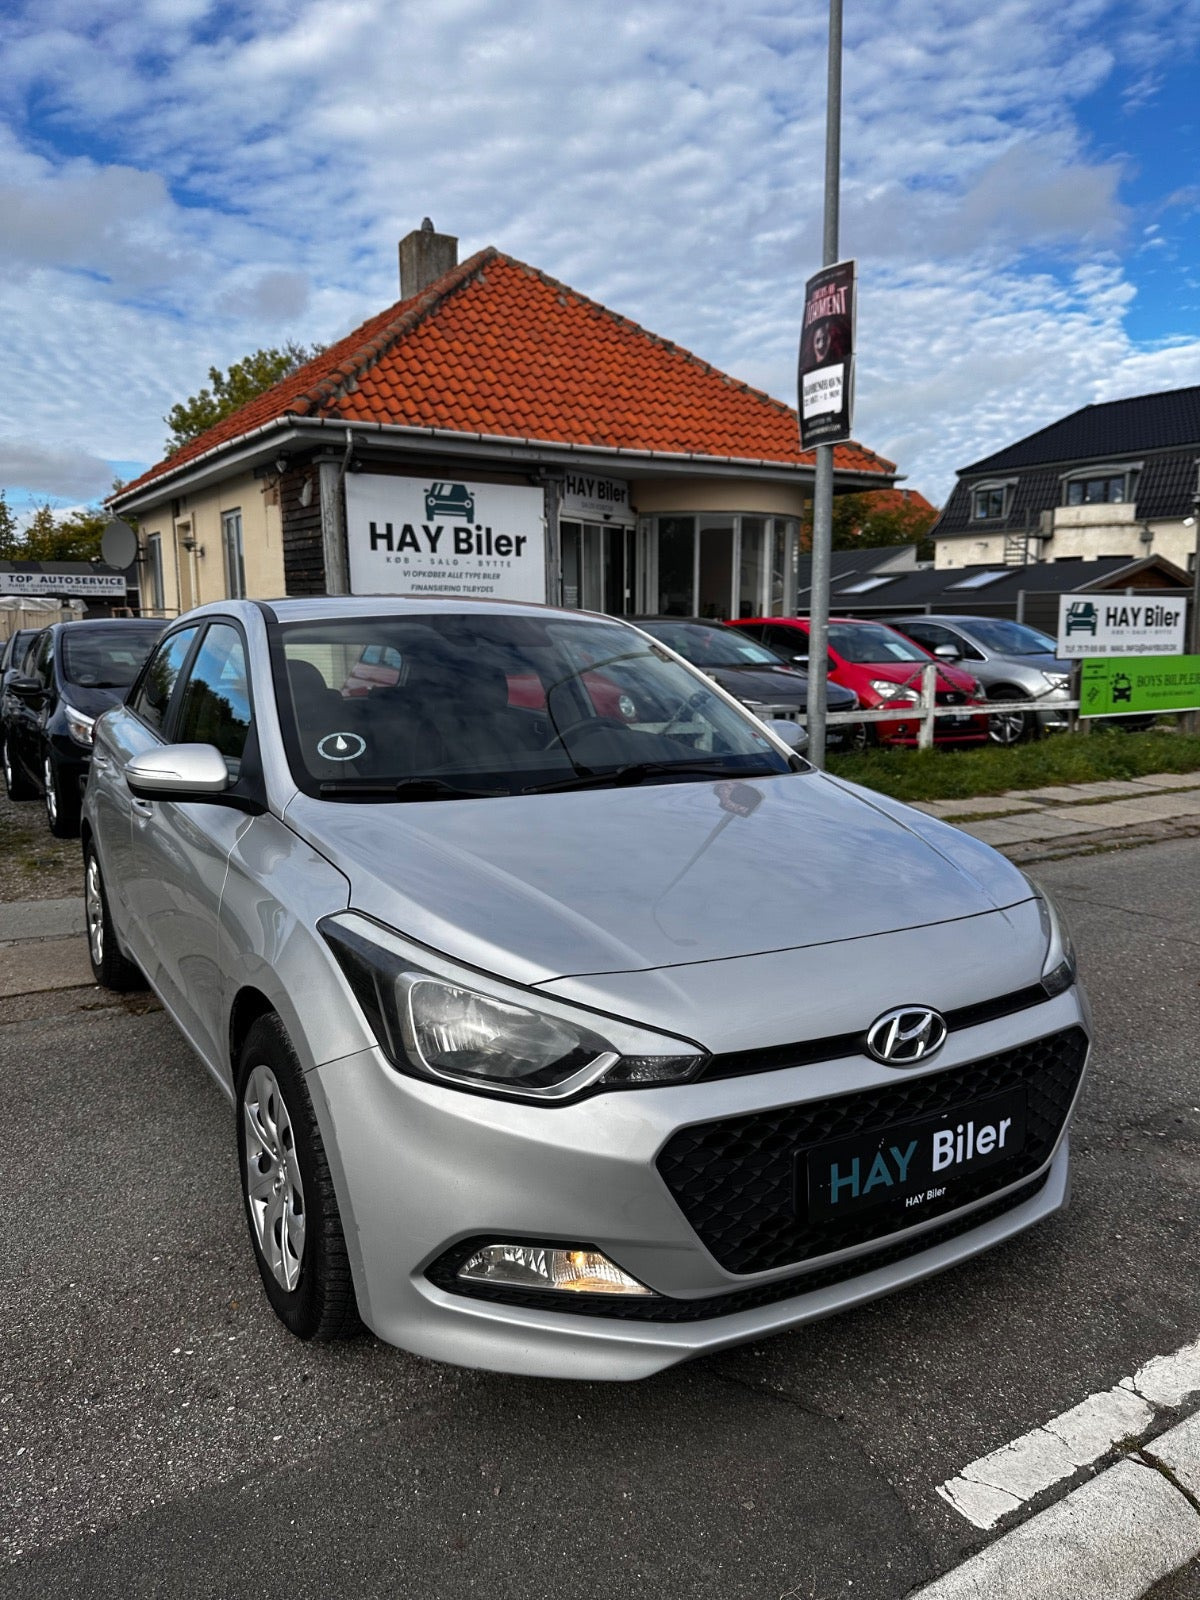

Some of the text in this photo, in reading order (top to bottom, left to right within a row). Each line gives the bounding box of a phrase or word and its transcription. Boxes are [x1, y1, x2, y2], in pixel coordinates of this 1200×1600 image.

[566, 475, 626, 503] HAY Biler
[369, 521, 527, 557] HAY Biler
[478, 560, 512, 568] BYTTE
[8, 575, 124, 585] TOP AUTOSERVICE
[447, 571, 464, 579] ALLE
[463, 585, 494, 593] TILBYDES
[1105, 605, 1180, 627] HAY Biler
[1136, 674, 1162, 687] BOYS
[830, 1117, 1011, 1204] HAY Biler
[905, 1186, 947, 1208] HAY Biler
